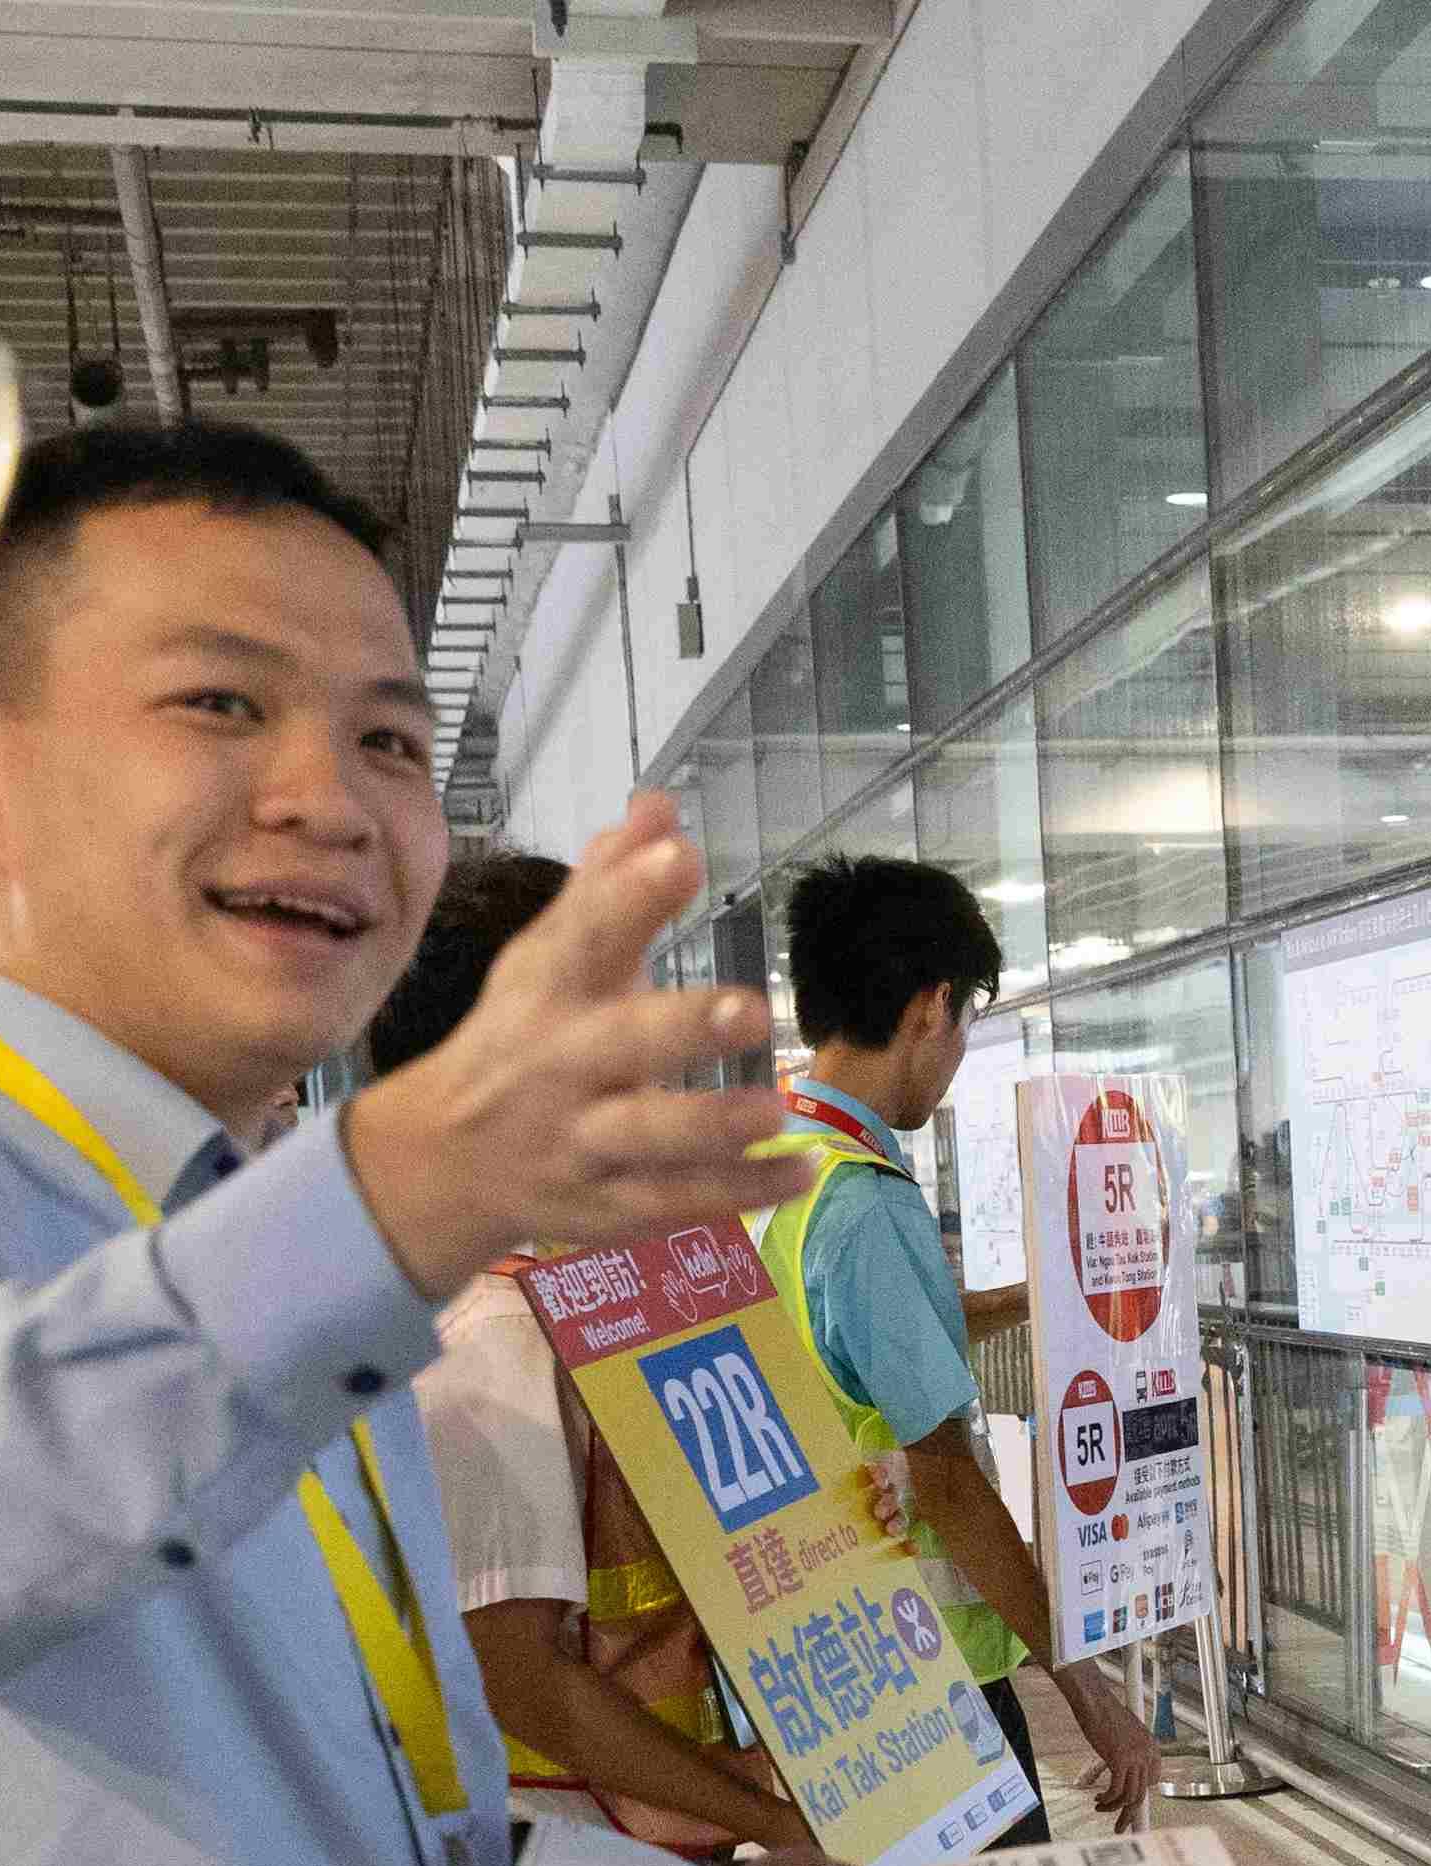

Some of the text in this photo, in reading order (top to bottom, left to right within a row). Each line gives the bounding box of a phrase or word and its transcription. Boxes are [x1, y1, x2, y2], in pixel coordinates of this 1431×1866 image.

[1102, 1109, 1130, 1137] KMB
[1104, 1163, 1137, 1213] 5R
[529, 1249, 647, 1323] 歡迎到訪!
[579, 1306, 651, 1350] Welcome!
[1151, 1368, 1176, 1397] KMB
[663, 1352, 805, 1513] 22R
[1076, 1421, 1106, 1467] 5R
[798, 1532, 844, 1571] direct
[839, 1523, 858, 1551] to
[1078, 1519, 1107, 1549] VISA
[800, 1705, 955, 1826] Kai Tak Station
